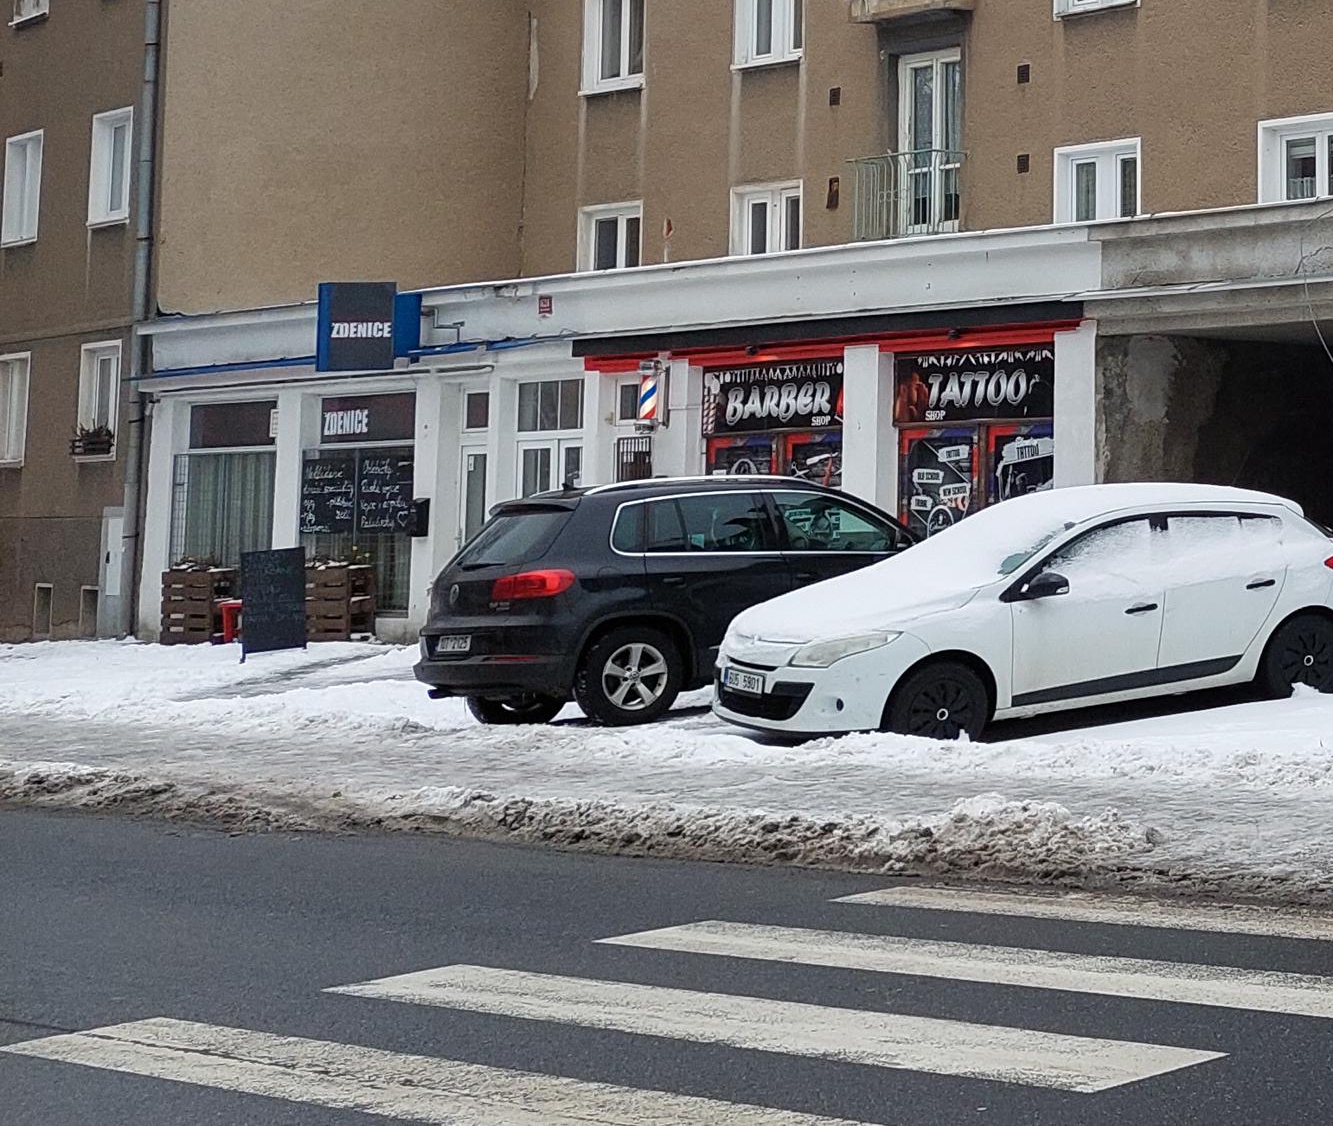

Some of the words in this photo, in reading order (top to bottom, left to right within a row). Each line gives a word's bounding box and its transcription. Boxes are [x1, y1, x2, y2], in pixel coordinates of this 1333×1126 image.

[330, 322, 393, 339] ZDENICE
[927, 368, 1028, 408] TATTOO
[725, 381, 832, 425] BARBER
[323, 409, 369, 436] ZDENICE
[811, 415, 831, 426] SHOP
[925, 410, 946, 421] SHOP
[1016, 444, 1040, 460] TATTOO
